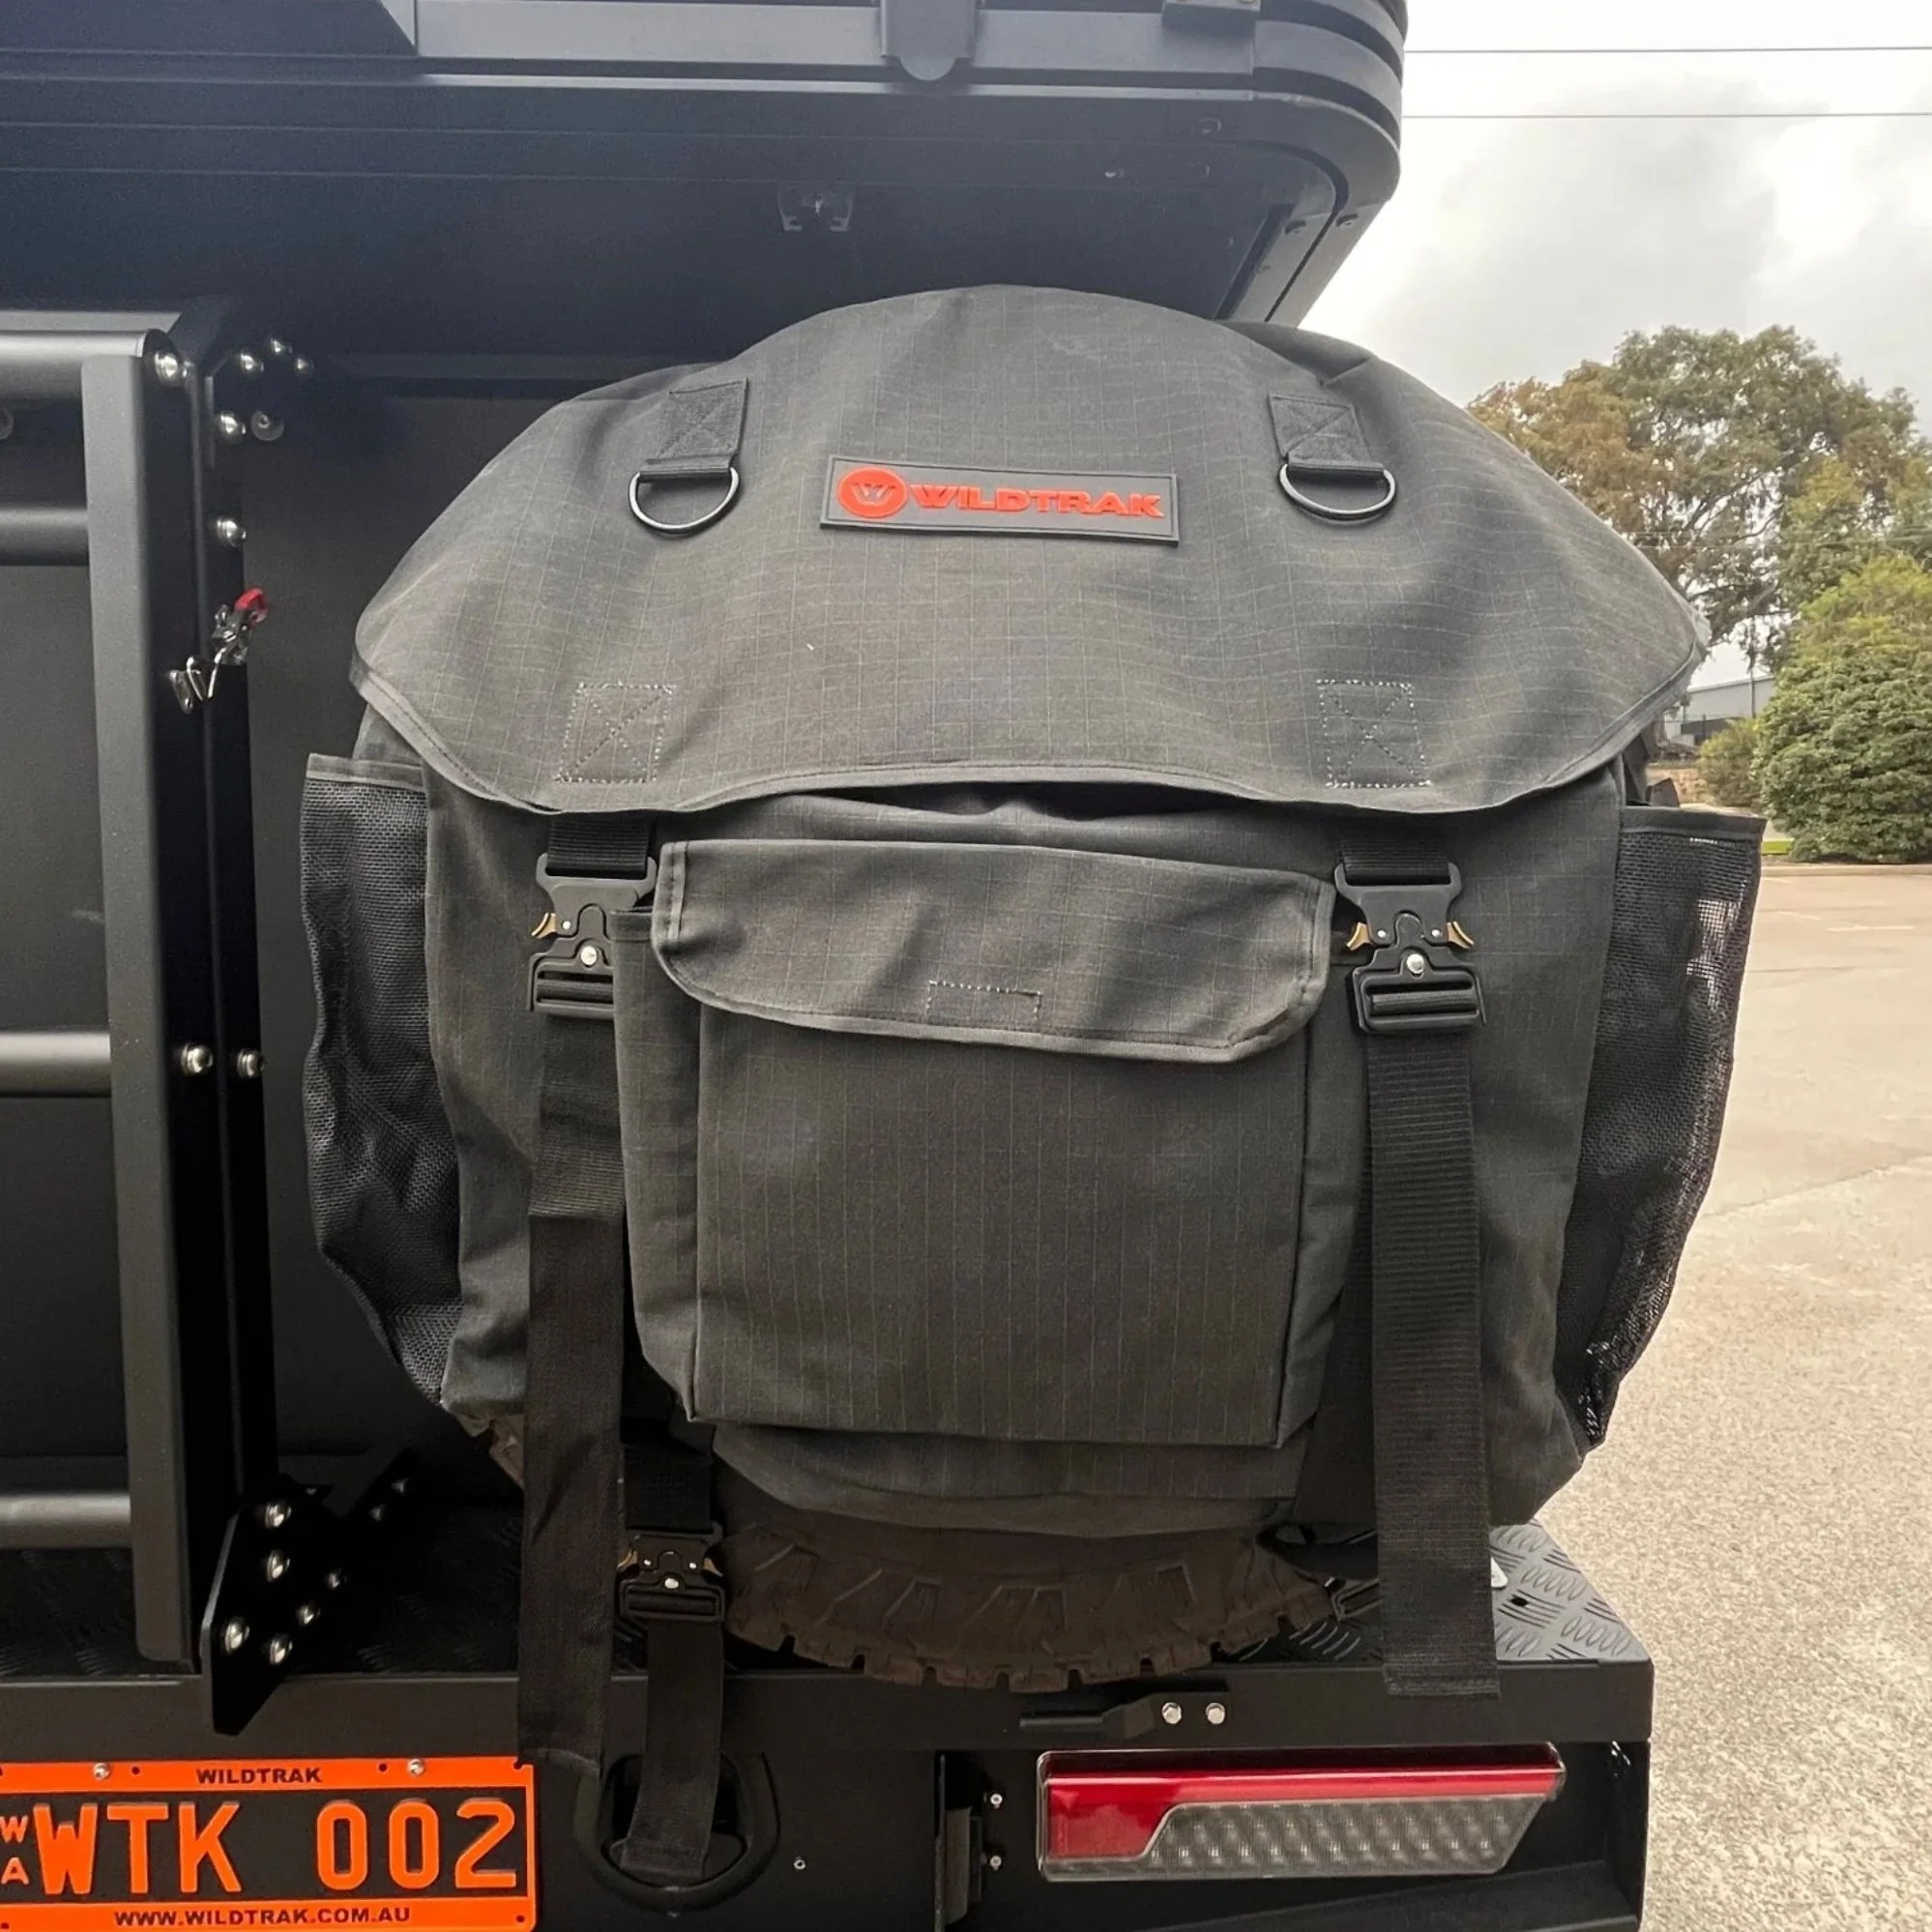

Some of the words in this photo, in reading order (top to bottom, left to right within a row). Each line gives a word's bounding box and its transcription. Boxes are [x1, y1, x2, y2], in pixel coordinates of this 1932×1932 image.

[910, 483, 1165, 518] WILDTRAK
[196, 1767, 322, 1785] WILDTRAK
[33, 1801, 242, 1895] WTK
[316, 1797, 517, 1891] 002
[113, 1906, 411, 1928] WWW.WILDTRAK.COM.AU
